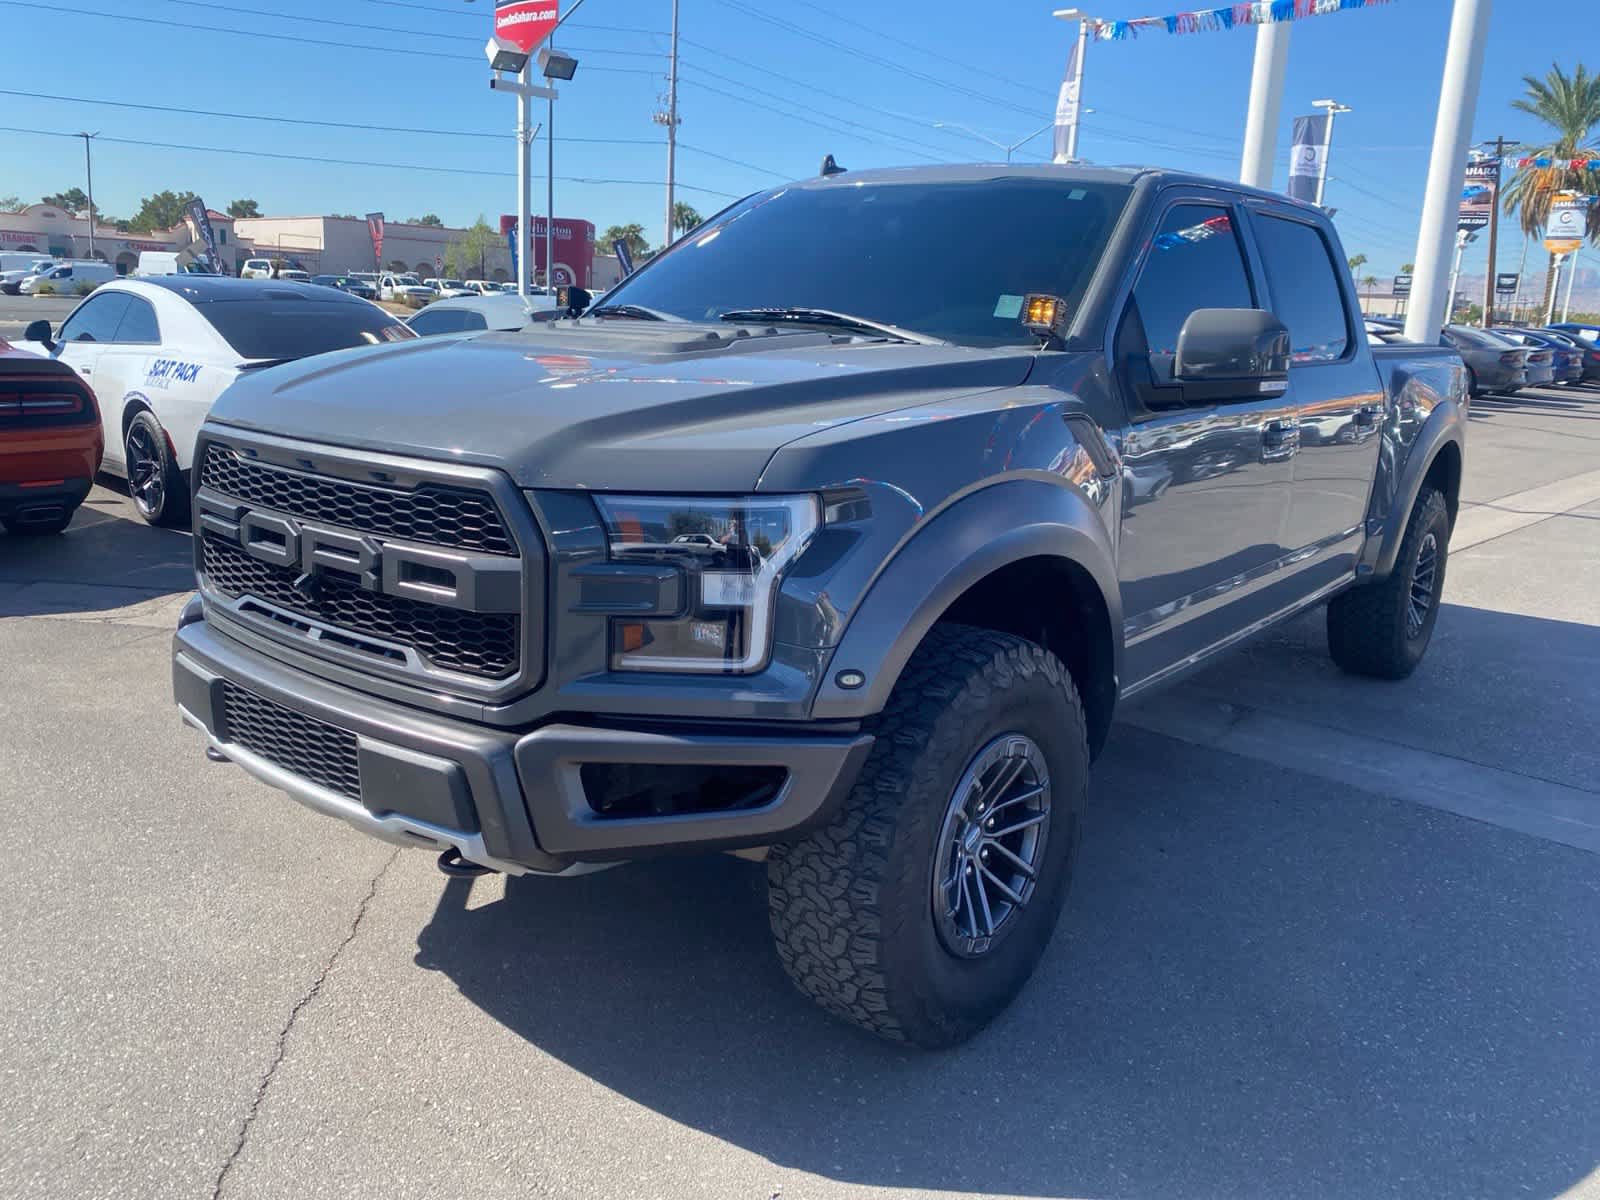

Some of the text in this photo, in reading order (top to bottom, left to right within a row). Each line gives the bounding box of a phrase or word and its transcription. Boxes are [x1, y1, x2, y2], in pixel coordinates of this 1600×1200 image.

[1464, 167, 1498, 176] AHARA
[149, 360, 202, 383] SCAT PACK
[199, 495, 478, 611] FORD
